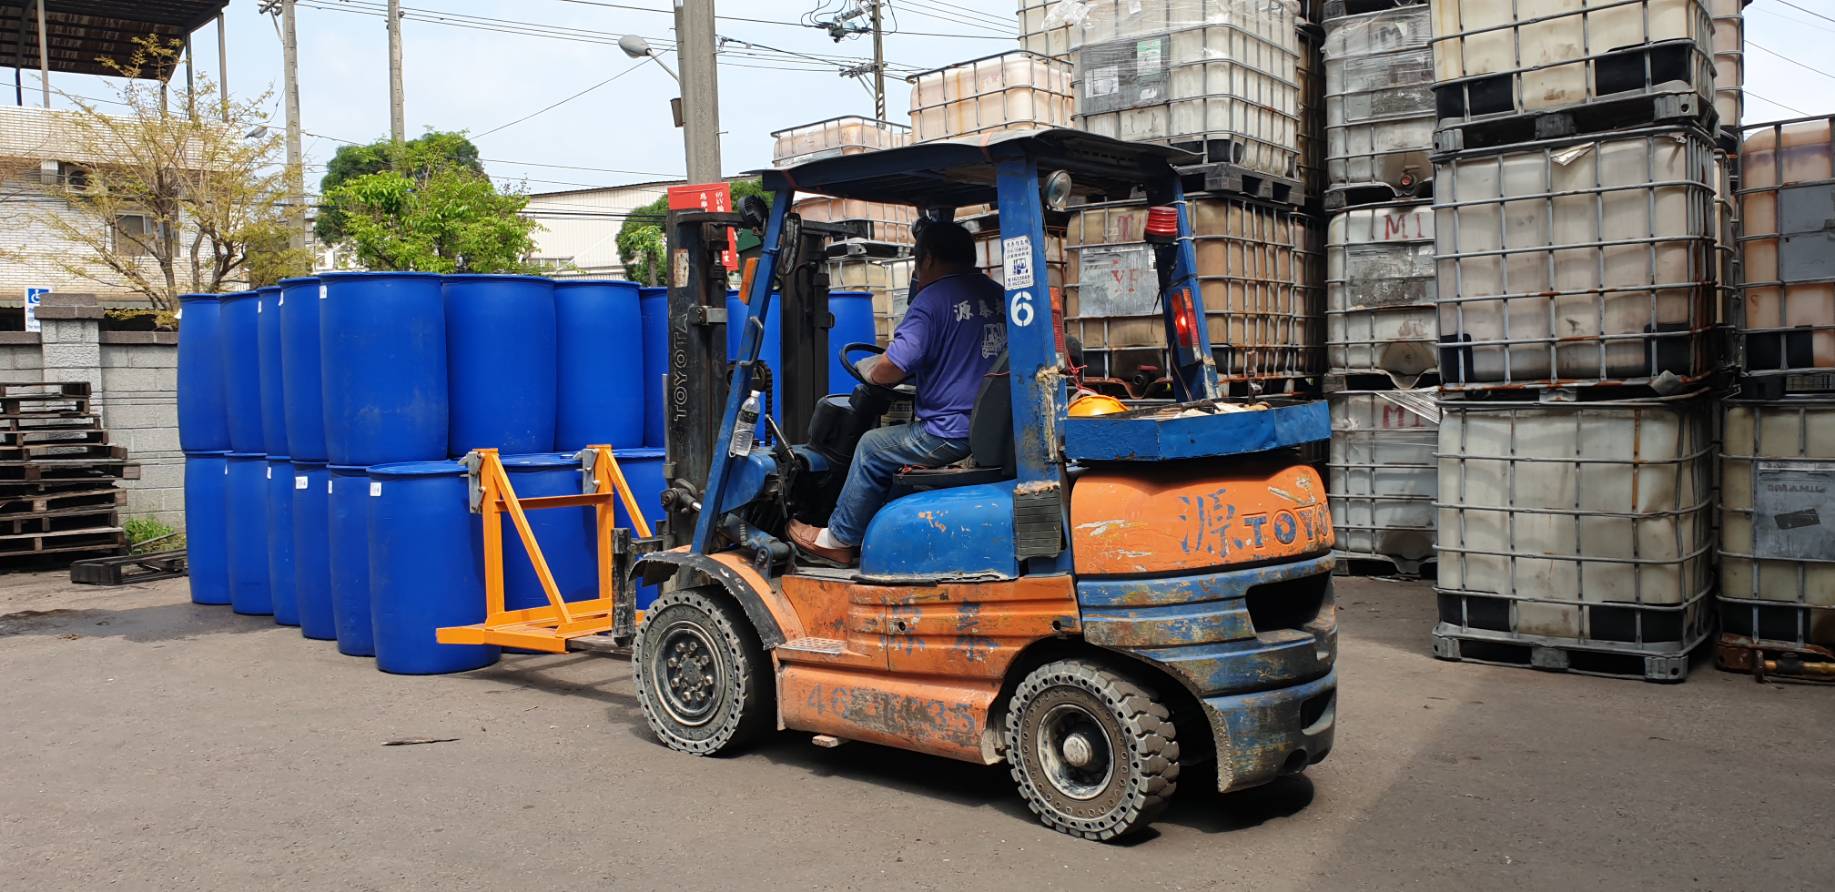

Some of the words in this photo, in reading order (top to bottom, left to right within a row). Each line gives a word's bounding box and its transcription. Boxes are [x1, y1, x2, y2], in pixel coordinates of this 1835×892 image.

[1010, 291, 1034, 327] 6
[673, 311, 688, 422] TOYOTA
[1179, 488, 1243, 558] 源
